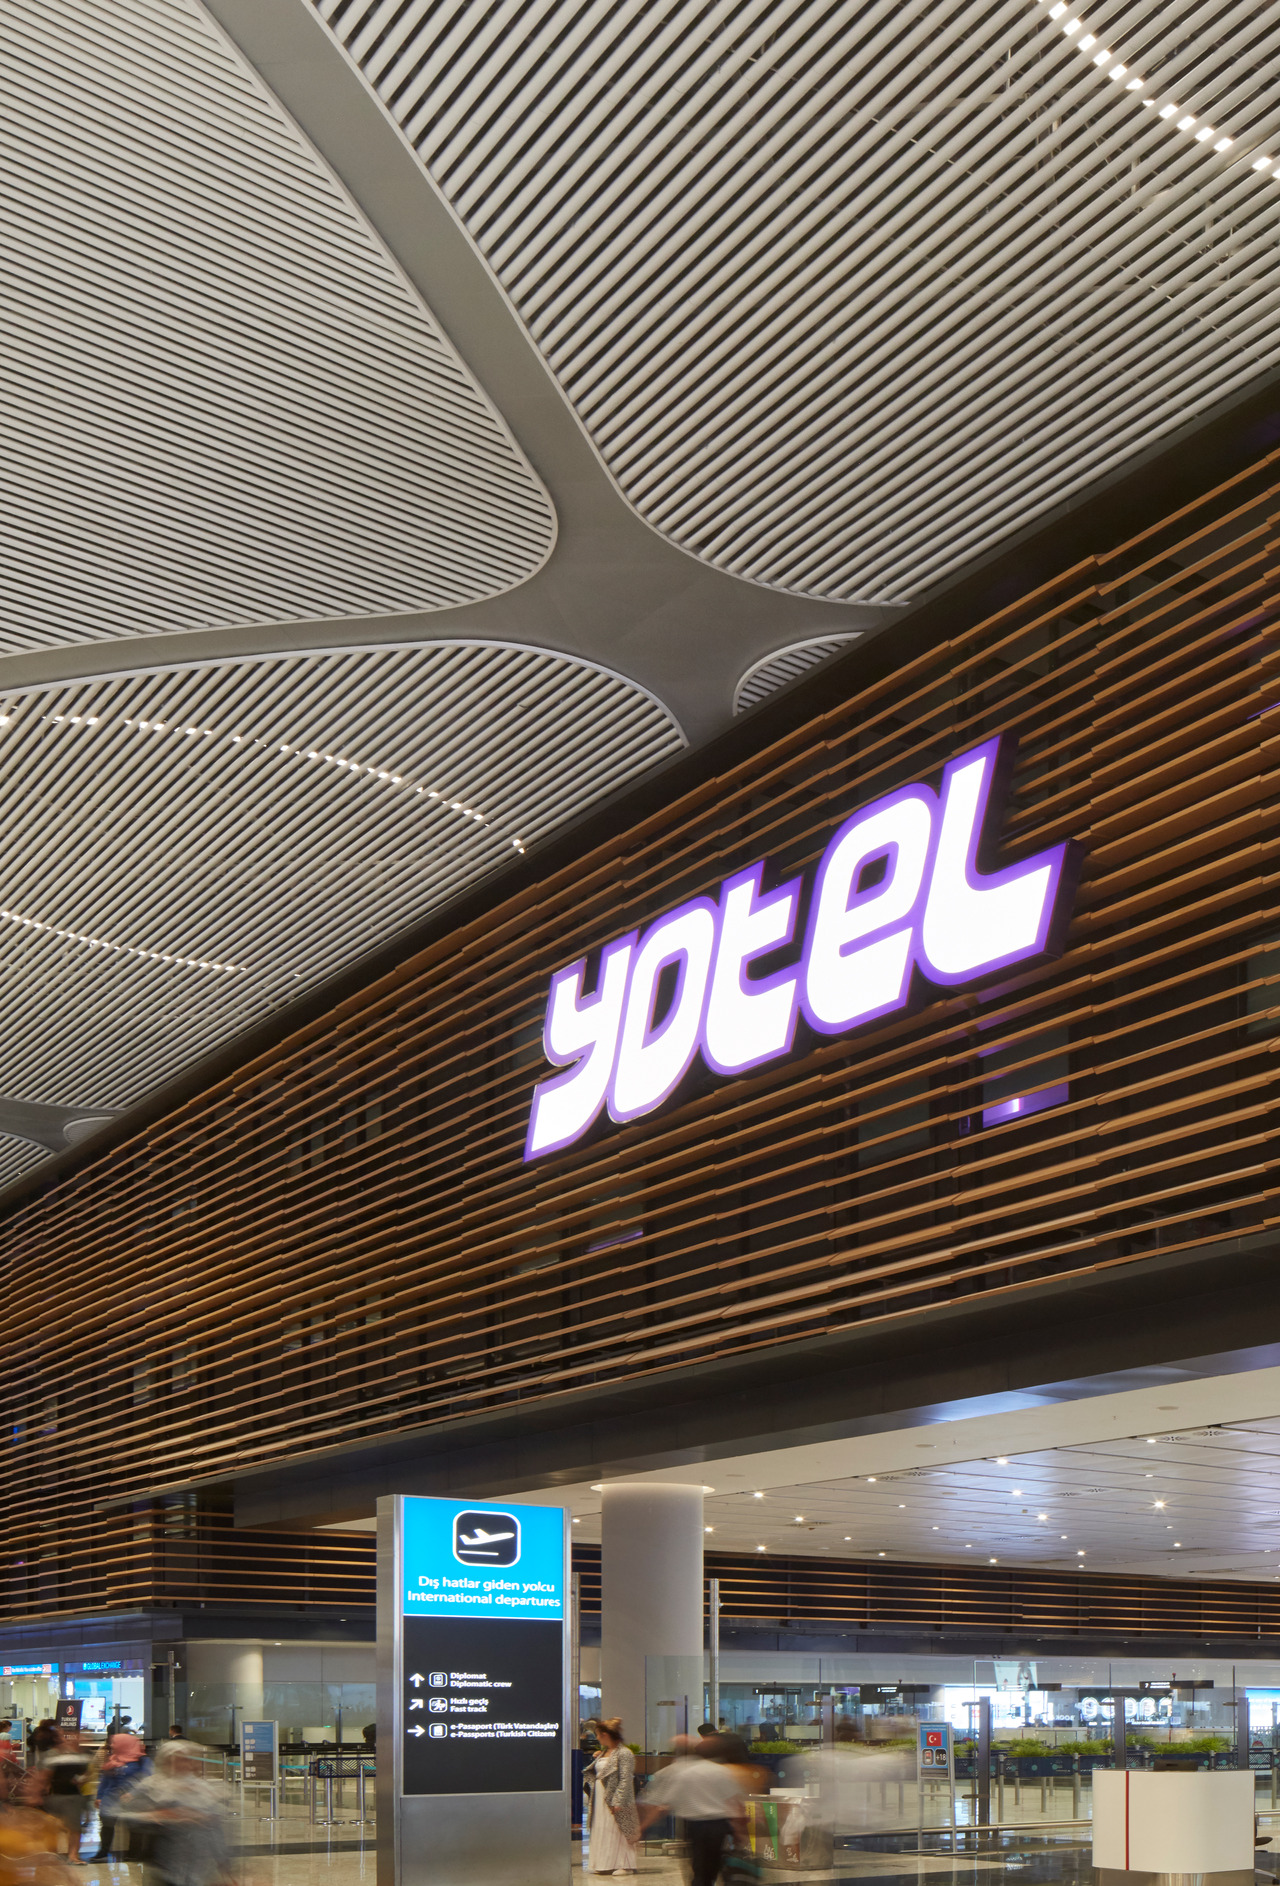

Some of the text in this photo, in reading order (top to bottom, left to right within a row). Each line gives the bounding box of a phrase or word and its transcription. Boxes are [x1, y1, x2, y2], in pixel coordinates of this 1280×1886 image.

[418, 1575, 555, 1593] Dış hatlar giden yolcu
[407, 1590, 561, 1607] International departures
[450, 1672, 487, 1680] Diplomat
[450, 1680, 493, 1688] Diplomatic
